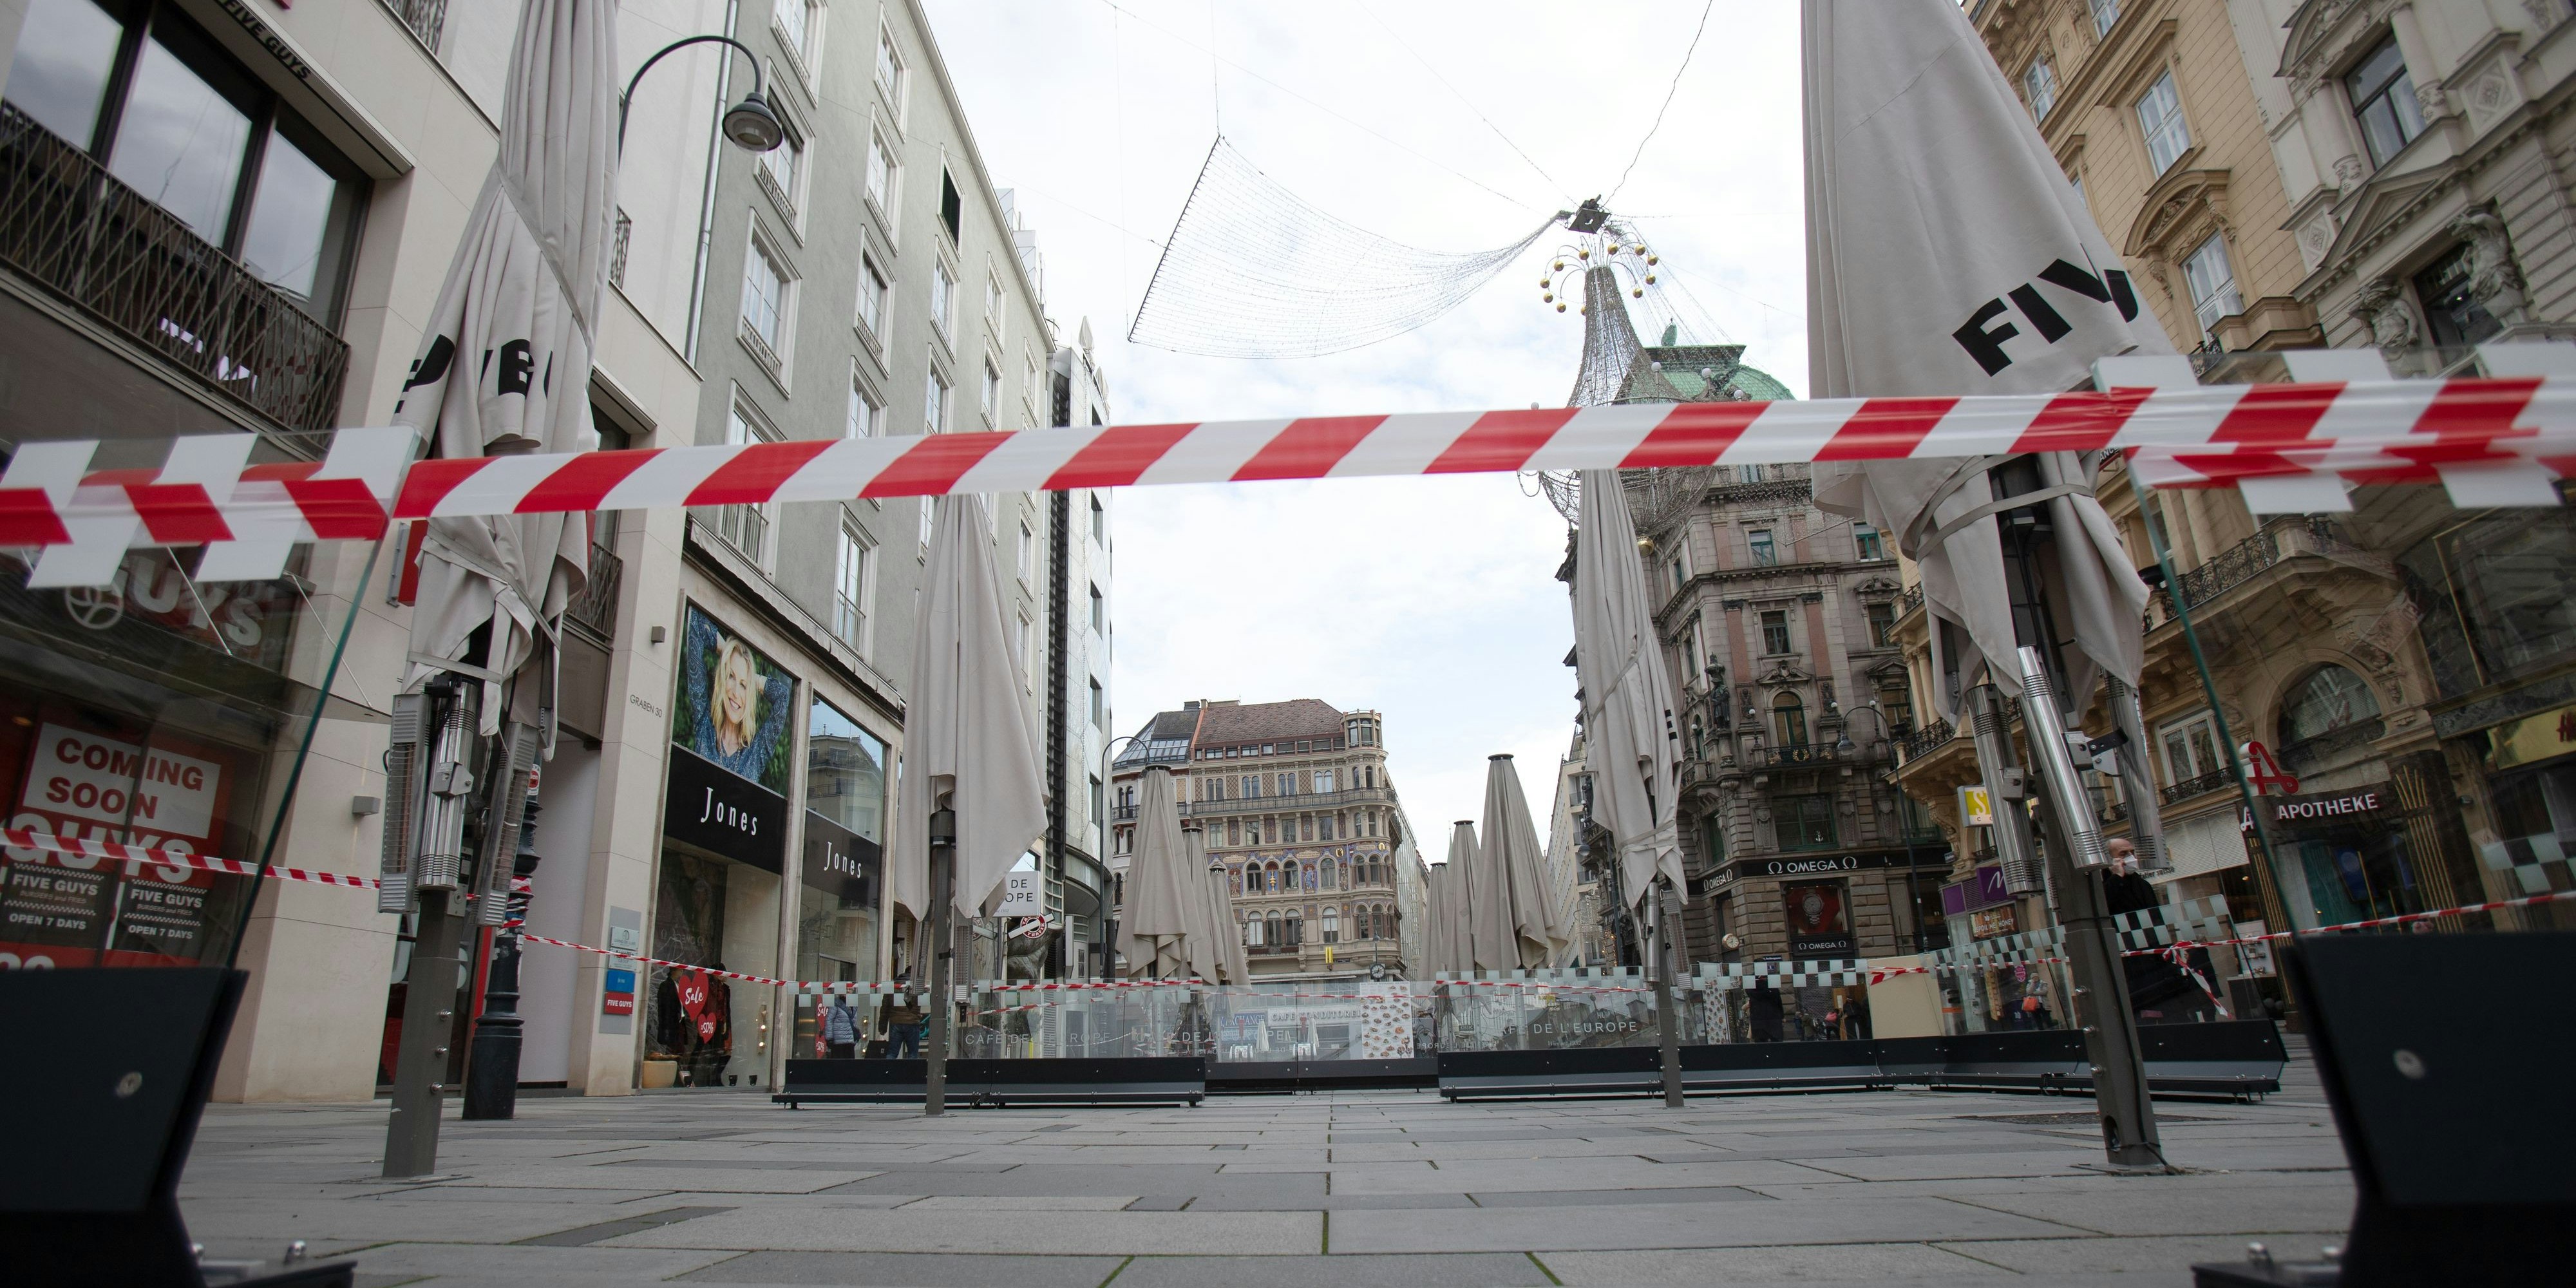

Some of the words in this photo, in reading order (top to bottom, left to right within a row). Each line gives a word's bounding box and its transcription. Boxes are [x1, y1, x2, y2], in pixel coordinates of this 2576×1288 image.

[223, 0, 266, 35] FIVE
[265, 37, 311, 78] GUYS
[1951, 243, 2138, 377] FIV
[111, 551, 264, 647] UYS
[630, 694, 654, 714] GRABEN
[655, 707, 663, 718] 30
[56, 737, 204, 791] COMING
[46, 777, 158, 819] SOON
[2277, 793, 2379, 820] APOTHEKE
[700, 786, 758, 836] Jones
[824, 841, 862, 878] Jones
[1787, 859, 1838, 873] OMEGA
[12, 873, 51, 889] FIVE
[54, 878, 99, 896] GUYS
[1011, 879, 1027, 888] DE
[1709, 874, 1727, 890] OMEGA
[130, 889, 162, 902] FIVE
[166, 893, 202, 909] GUYS
[1005, 893, 1033, 902] OPE
[9, 913, 42, 926] OPEN
[46, 918, 53, 926] 7
[56, 919, 86, 931] DAYS
[1027, 923, 1045, 937] TRAFIK
[1998, 918, 2014, 927] HONEY
[128, 925, 157, 936] OPEN
[167, 929, 193, 940] DAYS
[685, 987, 704, 1005] Sale
[817, 1003, 828, 1017] Sale
[1272, 1012, 1295, 1022] CAFE
[1534, 1023, 1553, 1034] DE
[1561, 1021, 1638, 1034] L'EUROPE
[1182, 1032, 1201, 1042] DE
